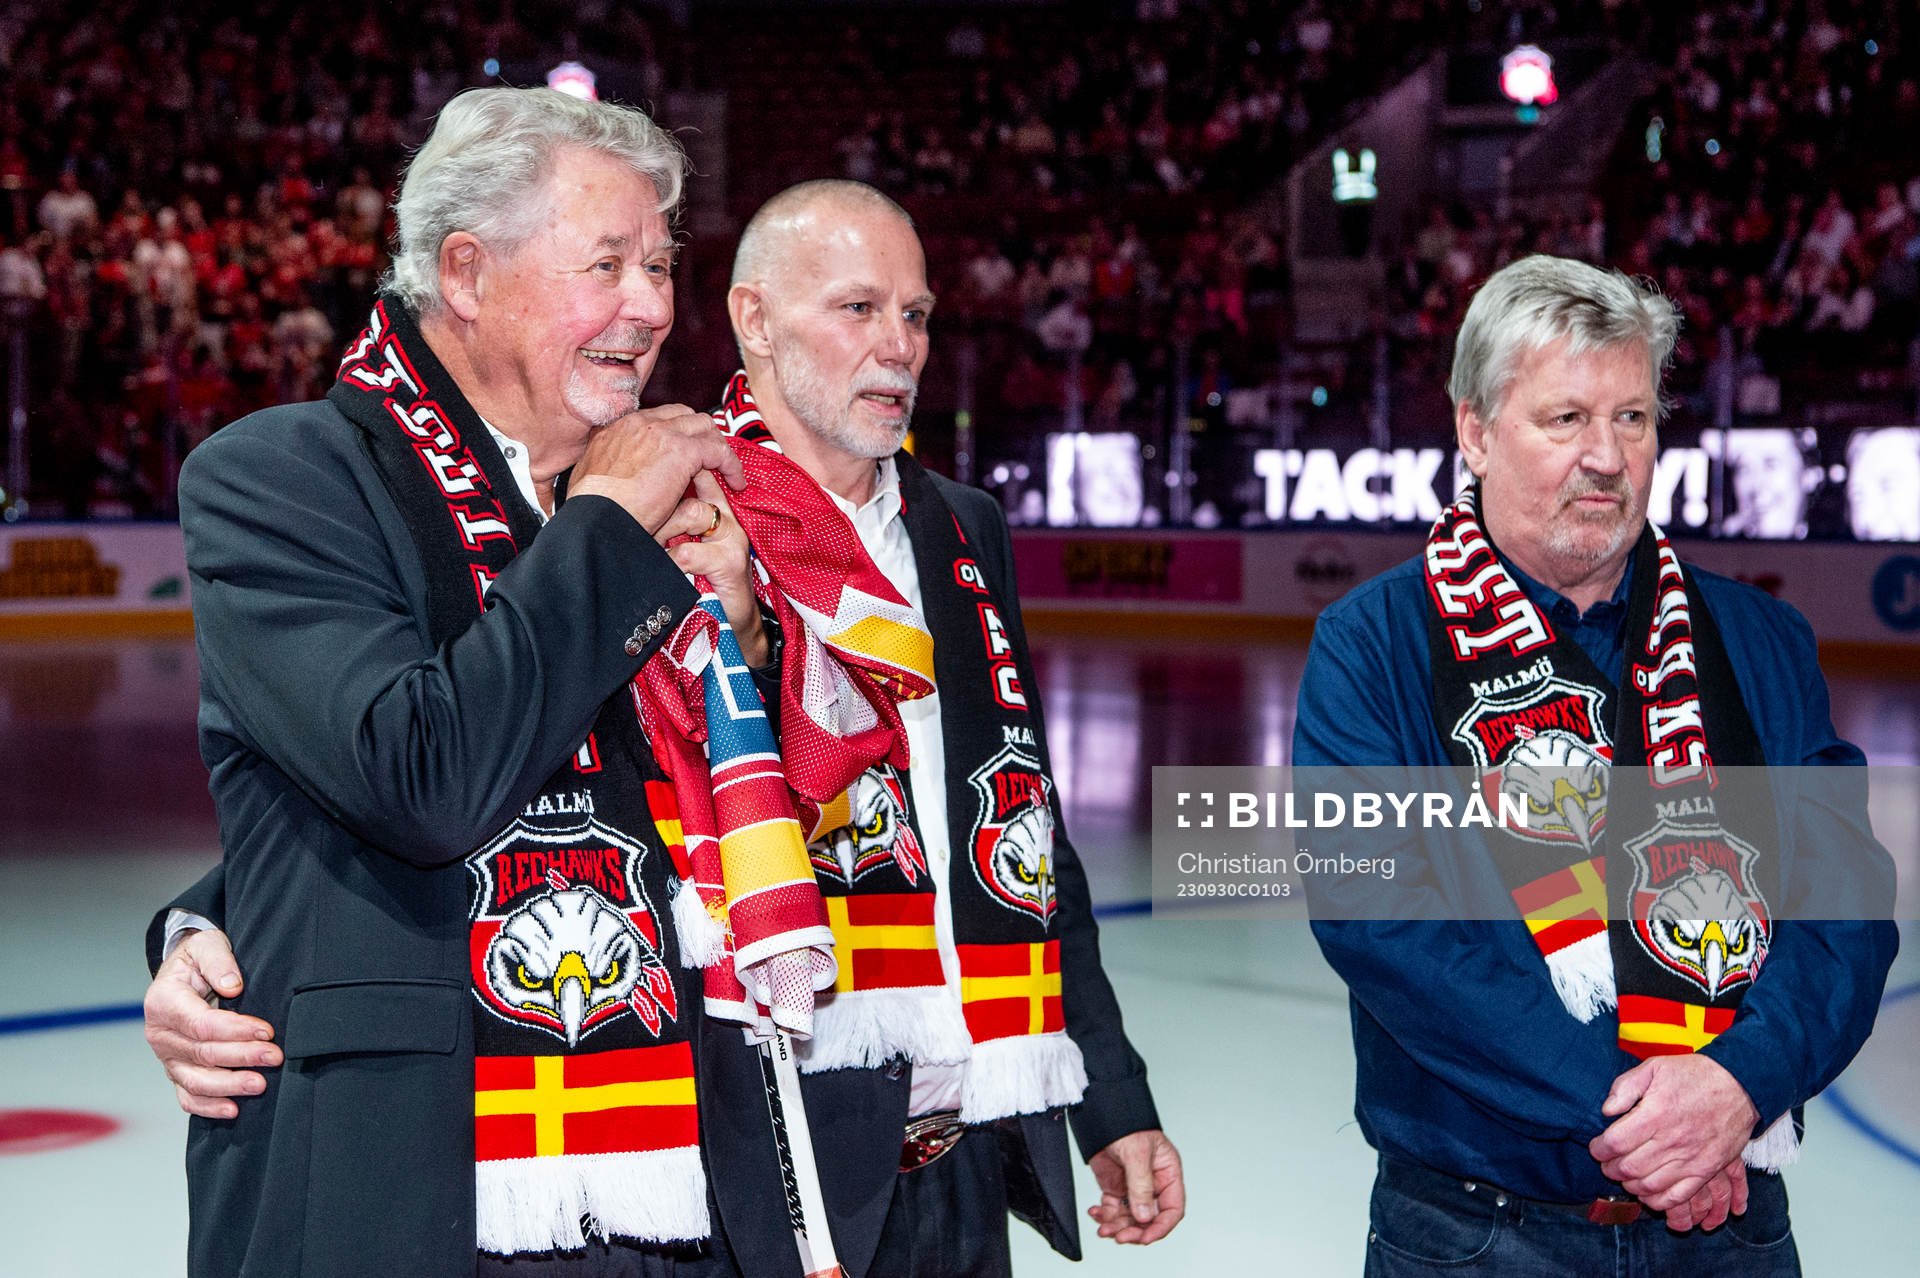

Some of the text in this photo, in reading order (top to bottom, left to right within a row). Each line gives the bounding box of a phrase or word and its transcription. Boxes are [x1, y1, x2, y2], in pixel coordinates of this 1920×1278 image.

[1254, 447, 1443, 521] TACK
[1469, 655, 1555, 698] MALMÖ
[1002, 725, 1036, 746] MA
[1475, 695, 1590, 762] REDHAWKS
[496, 847, 626, 908] REDHAWKS
